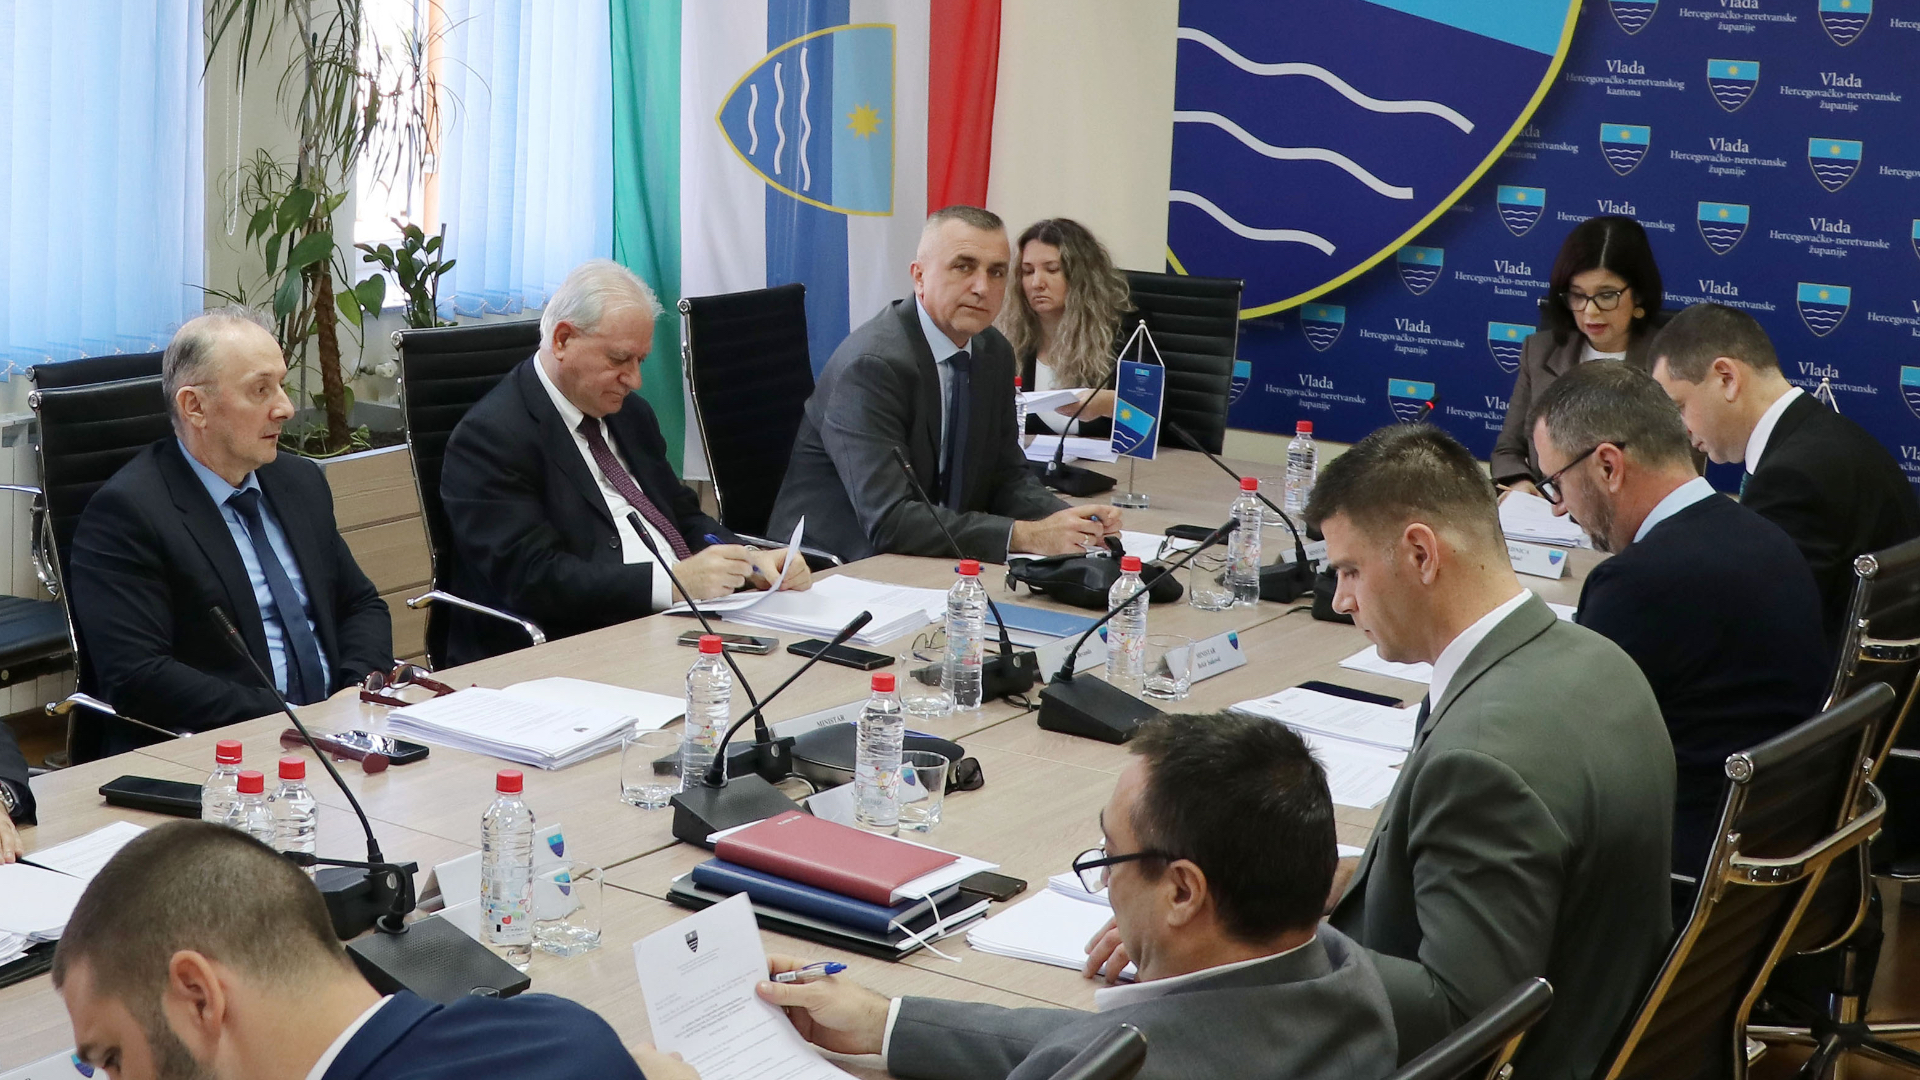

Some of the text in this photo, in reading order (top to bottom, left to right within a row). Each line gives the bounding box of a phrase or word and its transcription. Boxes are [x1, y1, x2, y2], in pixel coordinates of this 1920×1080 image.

[1720, 0, 1759, 9] Vlada
[1679, 8, 1797, 22] Hercegovačko-neretvanske
[1718, 22, 1756, 33] županije
[1606, 60, 1645, 75] Vlada
[1566, 73, 1685, 91] Hercegovačko-neretvanskog
[1820, 72, 1862, 88] Vlada
[1606, 86, 1641, 97] kantona
[1780, 85, 1902, 102] Hercegovačko-neretvanske
[1819, 100, 1859, 112] županije
[1518, 124, 1540, 138] ada
[1709, 137, 1749, 154] Vlada
[1670, 150, 1787, 168] Hercegovačko-neretvanske
[1708, 164, 1746, 177] županije
[1597, 200, 1636, 216] Vlada
[1809, 217, 1851, 234] Vlada
[1769, 230, 1890, 249] Hercegovačko-neretvanske
[1808, 245, 1847, 257] županije
[1494, 259, 1532, 276] Vlada
[1454, 270, 1551, 288] Hercegovačko-neretvan
[1494, 286, 1528, 297] kantona
[1698, 279, 1739, 296] Vlada
[1394, 317, 1431, 334] Vlada
[1360, 328, 1465, 348] Hercegovačko-neretvanske
[1394, 343, 1428, 356] županije
[1798, 361, 1839, 379] Vlada
[1298, 374, 1333, 390] Vlada
[1265, 383, 1367, 404] Hercegovačko-neretvanske
[1299, 398, 1331, 411] županije
[1485, 395, 1510, 410] Vla
[1485, 420, 1503, 431] kant
[816, 714, 846, 727] MINISTAR
